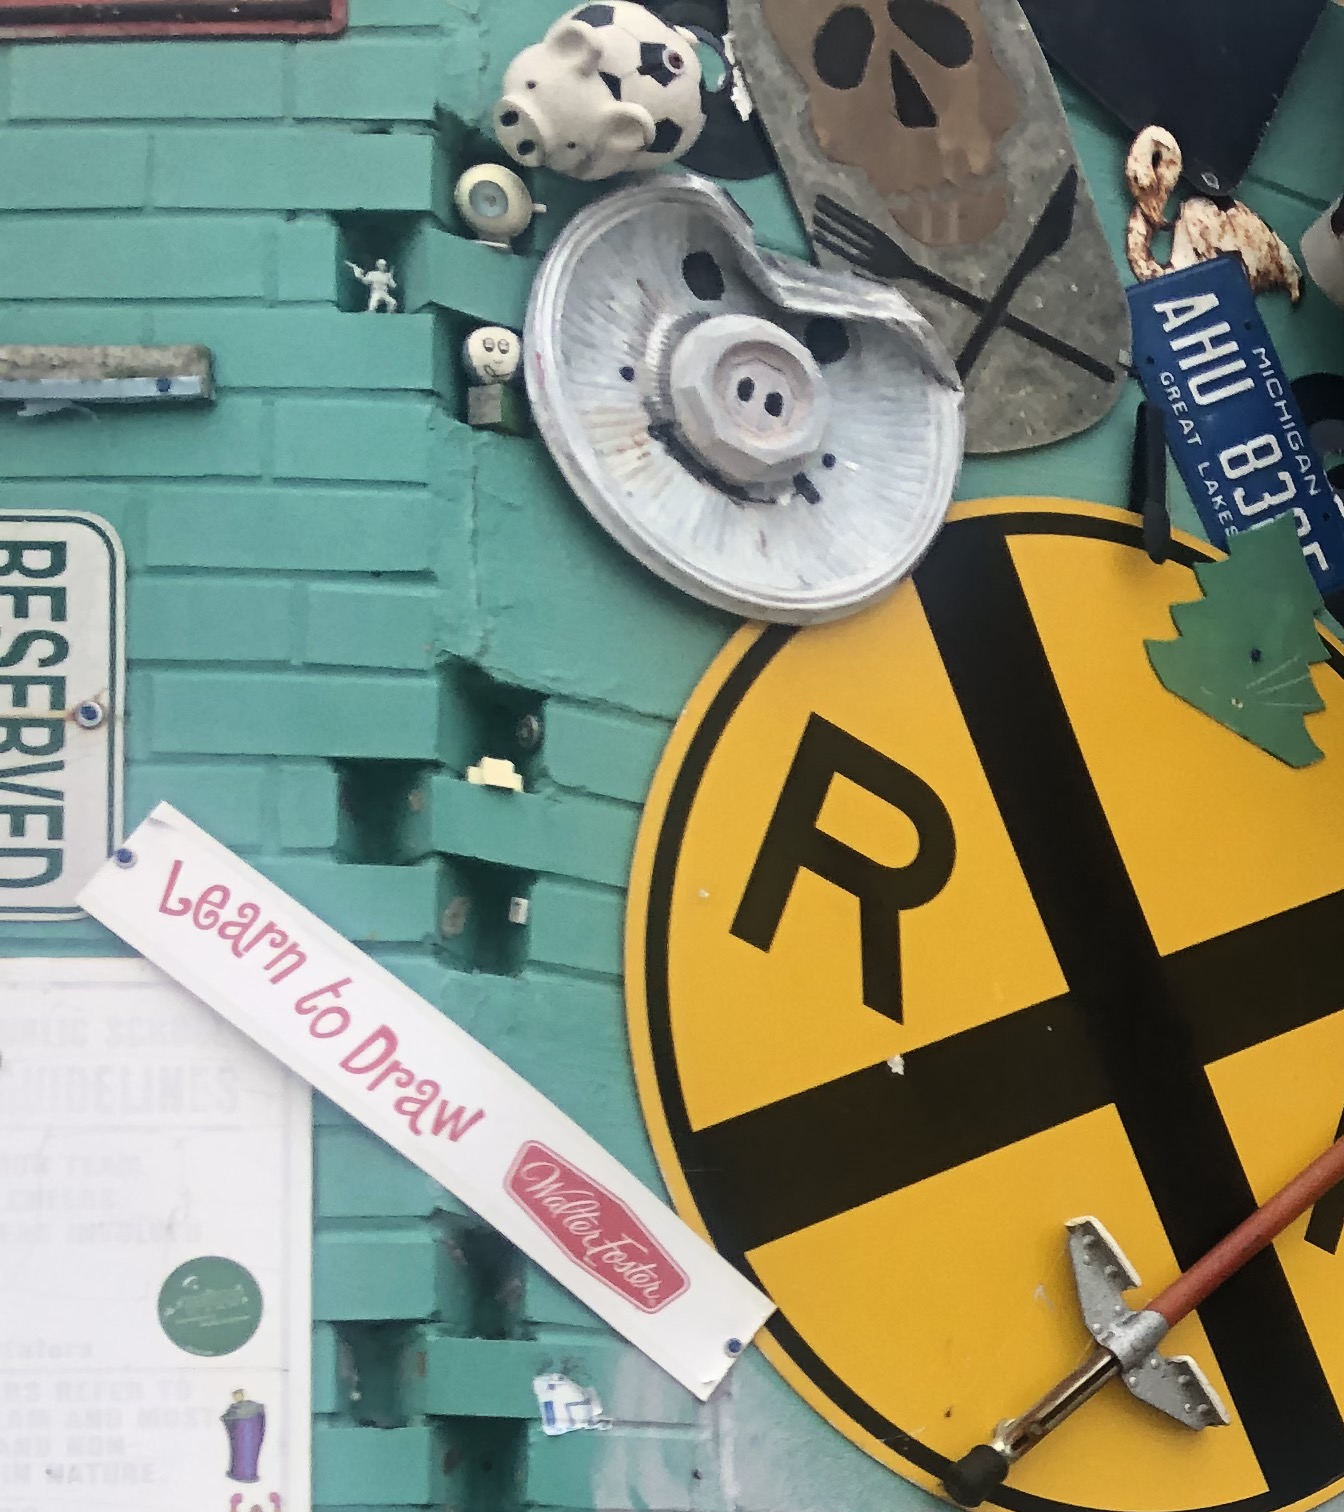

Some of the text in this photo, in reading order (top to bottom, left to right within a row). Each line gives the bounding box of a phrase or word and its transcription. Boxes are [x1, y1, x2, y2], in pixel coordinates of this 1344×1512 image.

[1152, 292, 1330, 572] AHU 83
[1159, 370, 1239, 538] GREAT LAKES
[1253, 346, 1321, 497] MICHIGAN
[0, 541, 69, 888] RESERVED
[158, 859, 488, 1142] Learn to Draw
[729, 712, 956, 1025] R
[520, 1160, 664, 1302] Walter Foster
